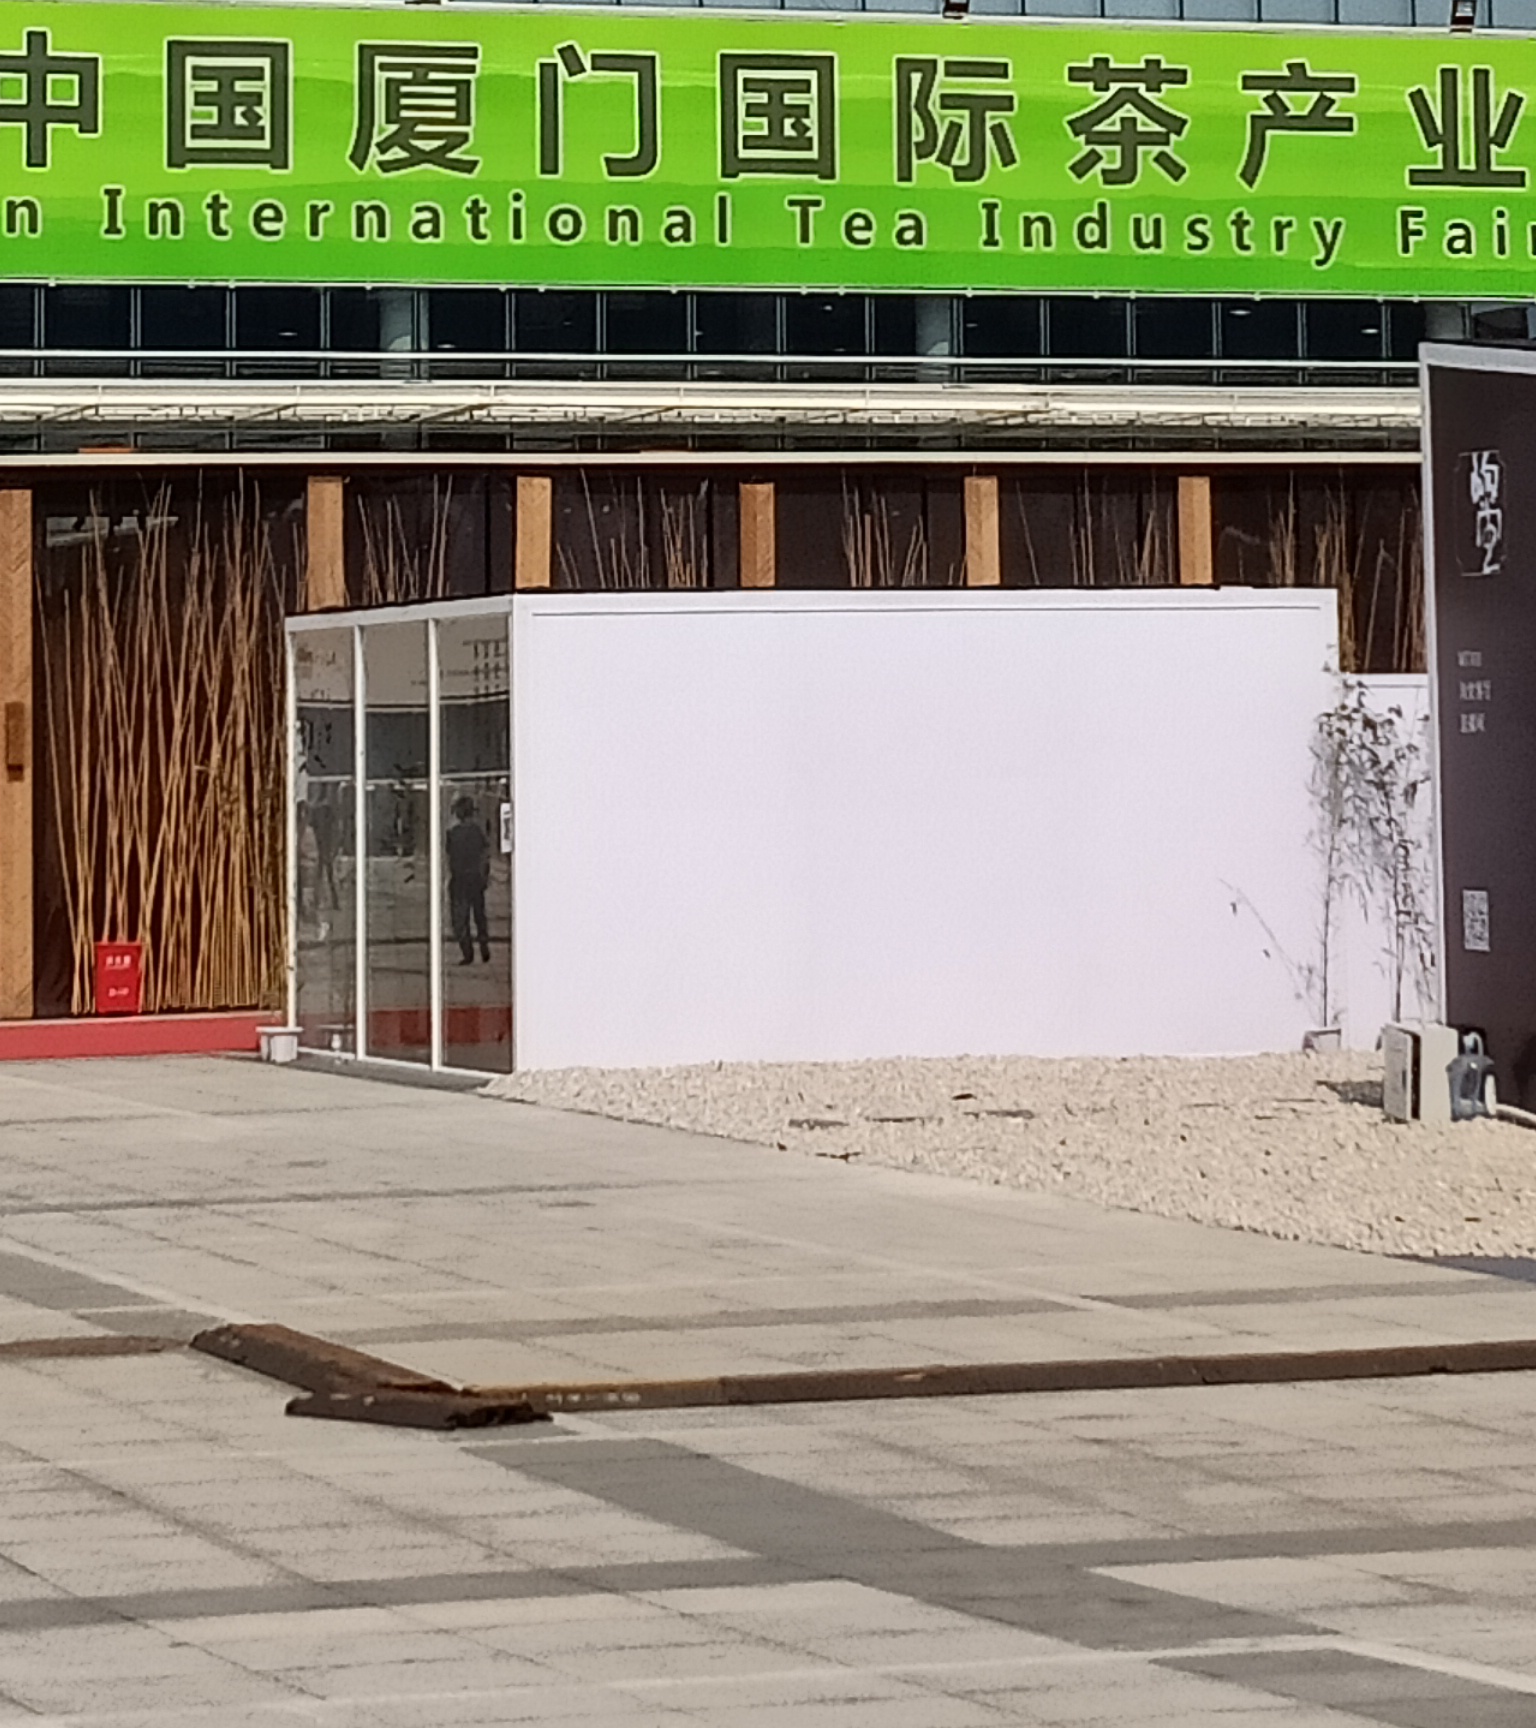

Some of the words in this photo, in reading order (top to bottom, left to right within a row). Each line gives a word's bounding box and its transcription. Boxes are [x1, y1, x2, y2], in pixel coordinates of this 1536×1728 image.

[104, 187, 728, 245] International
[786, 198, 924, 247] Tea
[981, 200, 1343, 268] Industry
